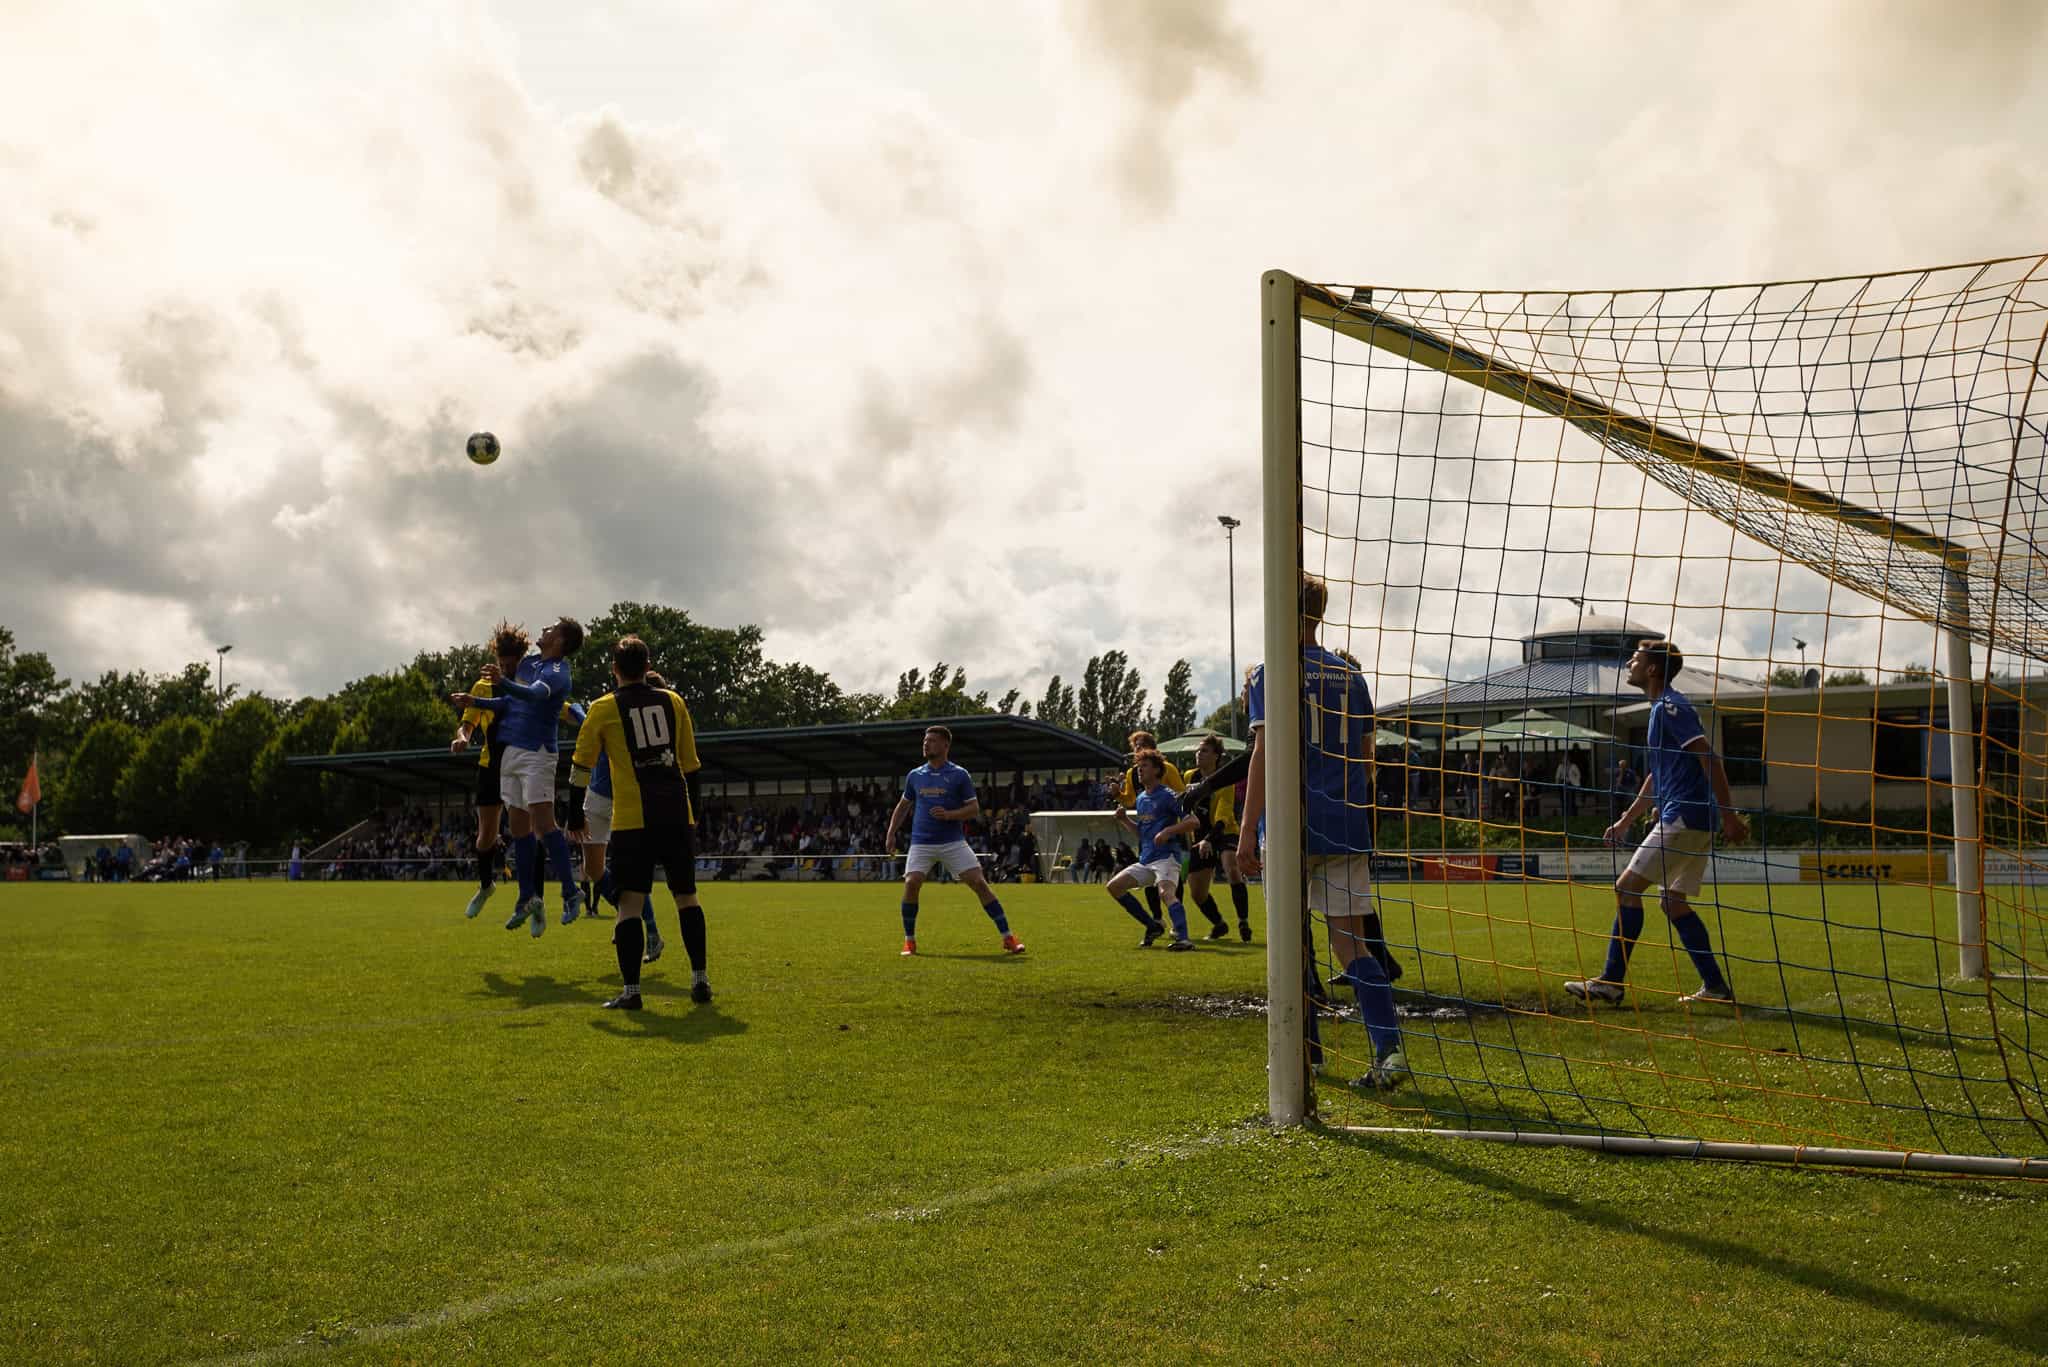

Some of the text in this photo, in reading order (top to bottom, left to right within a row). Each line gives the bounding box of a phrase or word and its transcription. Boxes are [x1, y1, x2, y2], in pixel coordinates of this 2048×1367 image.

[630, 706, 670, 749] 10
[1309, 694, 1348, 744] 11
[1826, 864, 1892, 878] SCHOT
